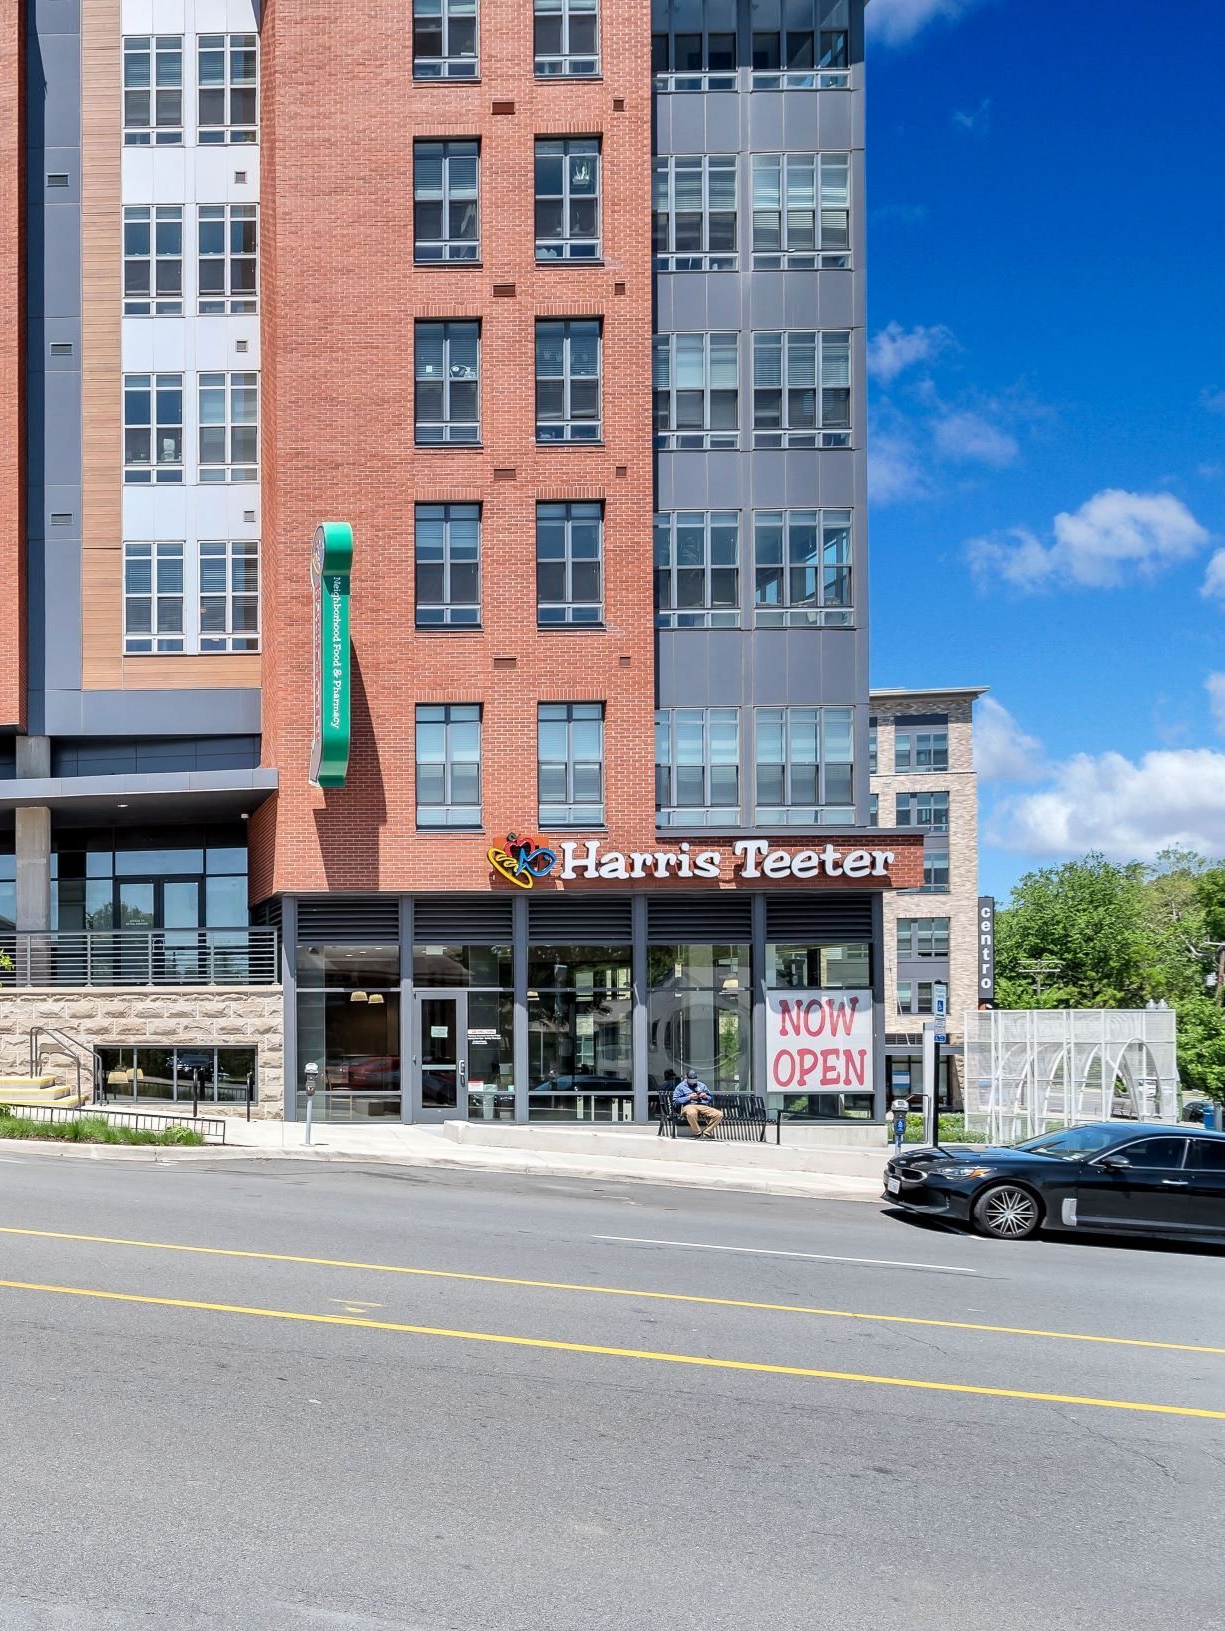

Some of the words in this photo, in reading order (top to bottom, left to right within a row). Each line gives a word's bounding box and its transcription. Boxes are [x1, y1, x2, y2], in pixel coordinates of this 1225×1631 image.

[331, 577, 342, 642] Neighborhood
[334, 644, 342, 666] Food
[334, 669, 342, 678] &
[330, 680, 342, 728] Pharmacy
[559, 841, 721, 880] Harris
[733, 839, 895, 879] Teeter
[980, 907, 992, 989] centro
[779, 996, 859, 1037] NOW
[773, 1048, 867, 1087] OPEN
